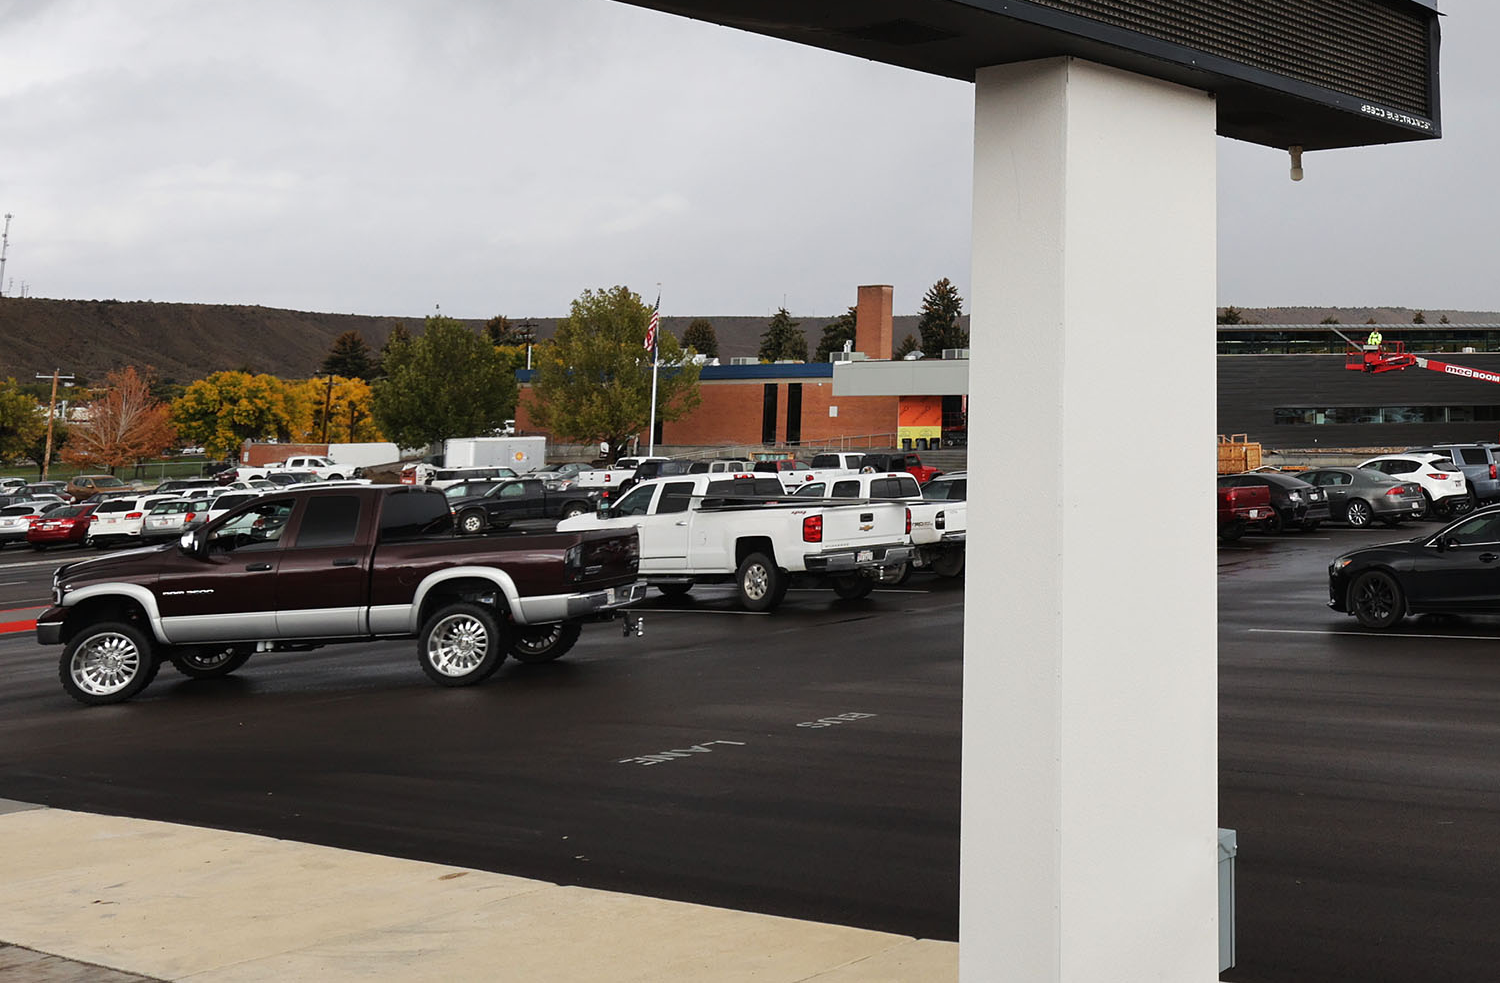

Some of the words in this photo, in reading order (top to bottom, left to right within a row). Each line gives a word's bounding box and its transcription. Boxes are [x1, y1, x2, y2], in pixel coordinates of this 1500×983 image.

[1446, 365, 1472, 377] mec
[1472, 371, 1500, 383] BOOM
[795, 711, 879, 729] BUS
[617, 739, 747, 767] LANE
